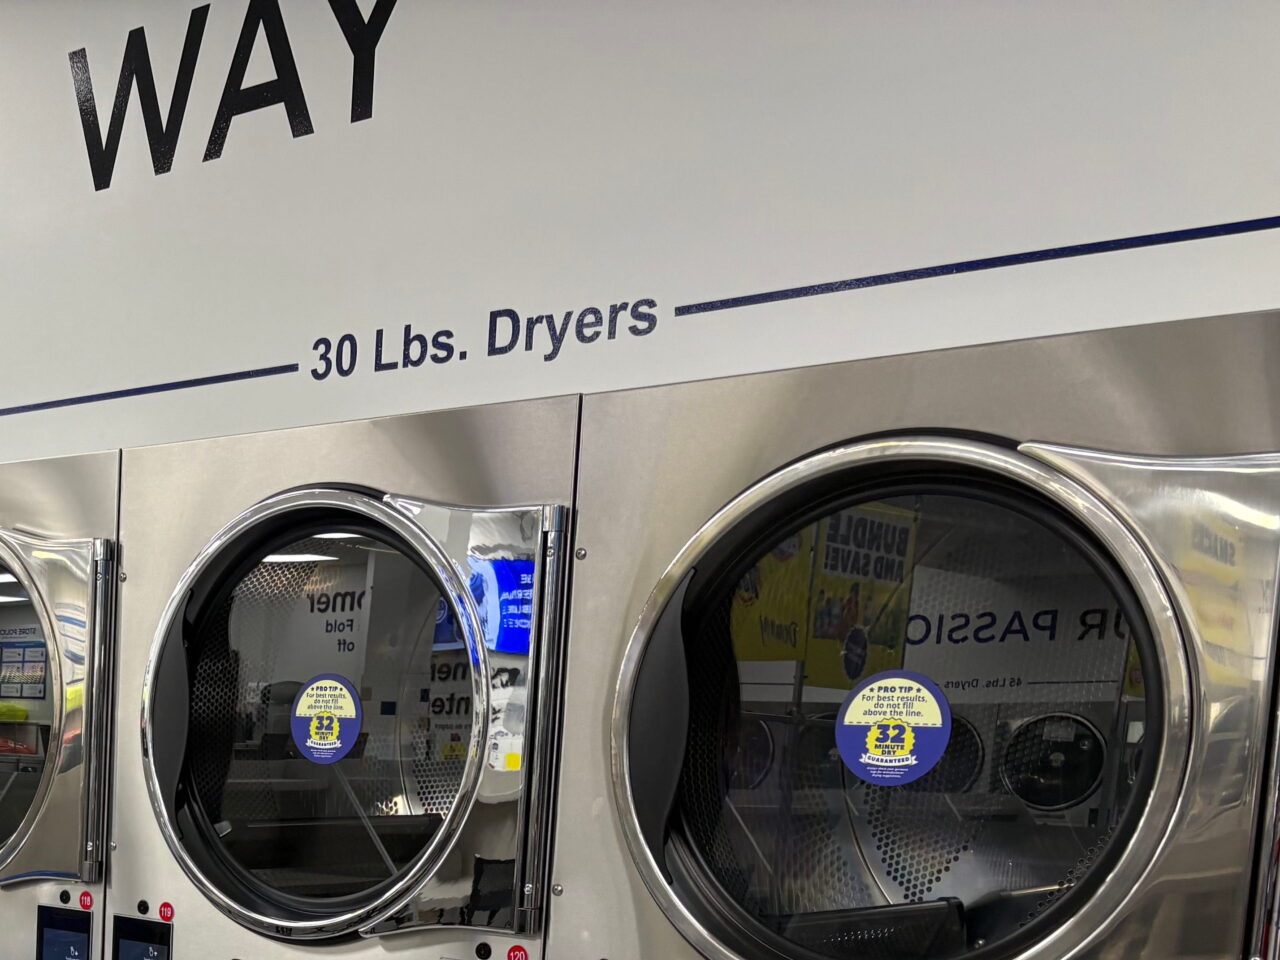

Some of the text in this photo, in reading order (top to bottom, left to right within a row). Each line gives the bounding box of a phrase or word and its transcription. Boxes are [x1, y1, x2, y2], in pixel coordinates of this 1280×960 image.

[69, 0, 398, 192] WAY
[311, 298, 657, 381] 30 Lbs. Dryers
[316, 716, 334, 730] 32
[875, 724, 906, 743] 32
[867, 755, 910, 763] GUARANTEED
[81, 896, 90, 905] 118
[161, 907, 171, 917] 119
